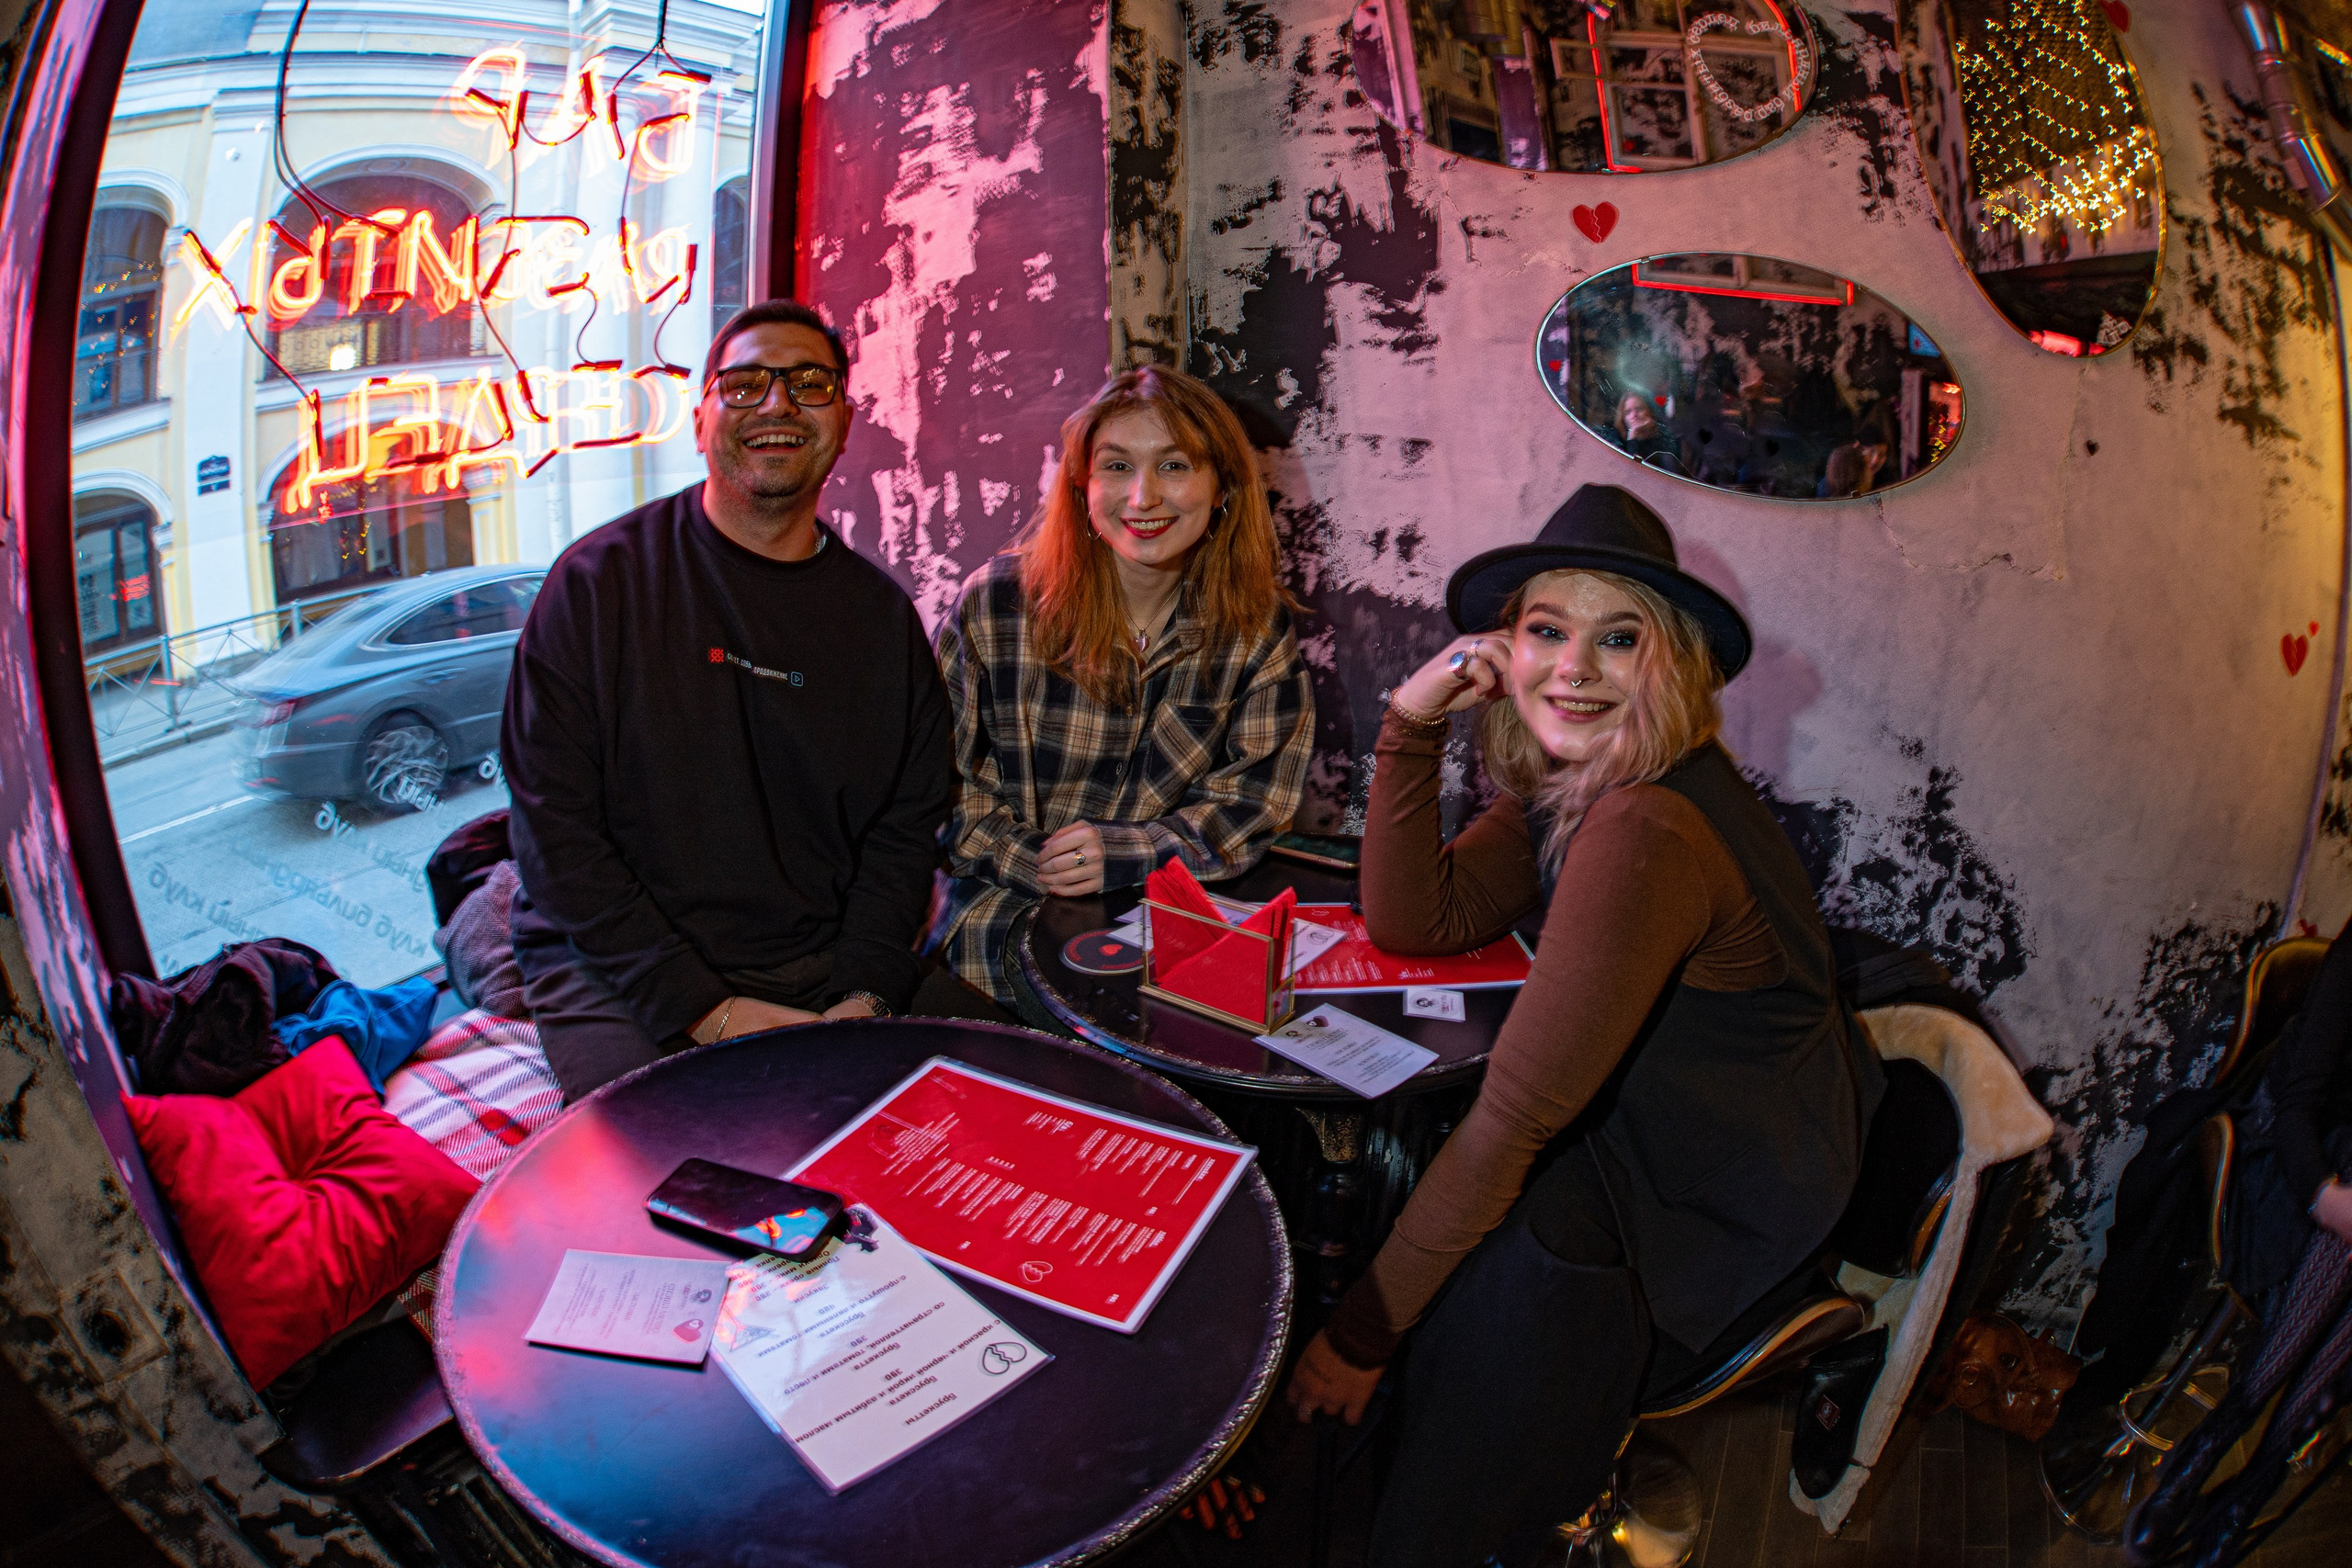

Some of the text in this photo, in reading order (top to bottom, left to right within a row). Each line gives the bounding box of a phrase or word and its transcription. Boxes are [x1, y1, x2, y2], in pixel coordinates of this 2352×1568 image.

[1689, 12, 1740, 44] сердец
[1690, 48, 1755, 122] разбитых
[1754, 96, 1785, 120] бар
[805, 1253, 840, 1278] Пряные
[778, 1270, 804, 1290] орехи
[793, 1280, 830, 1306] Закуски
[857, 1277, 899, 1305] прошутто
[933, 1300, 945, 1311] со
[756, 1329, 802, 1359] томатами
[955, 1322, 995, 1351] красной
[820, 1347, 865, 1376] томатами
[852, 1339, 900, 1372] Брускетта
[914, 1350, 950, 1377] черной
[783, 1376, 810, 1395] песто
[883, 1366, 902, 1382] 390
[886, 1371, 916, 1393] икрой
[888, 1373, 937, 1407] Брусскета
[833, 1393, 878, 1425] взбитым
[903, 1391, 957, 1427] Брускетты
[794, 1417, 832, 1445] маслом
